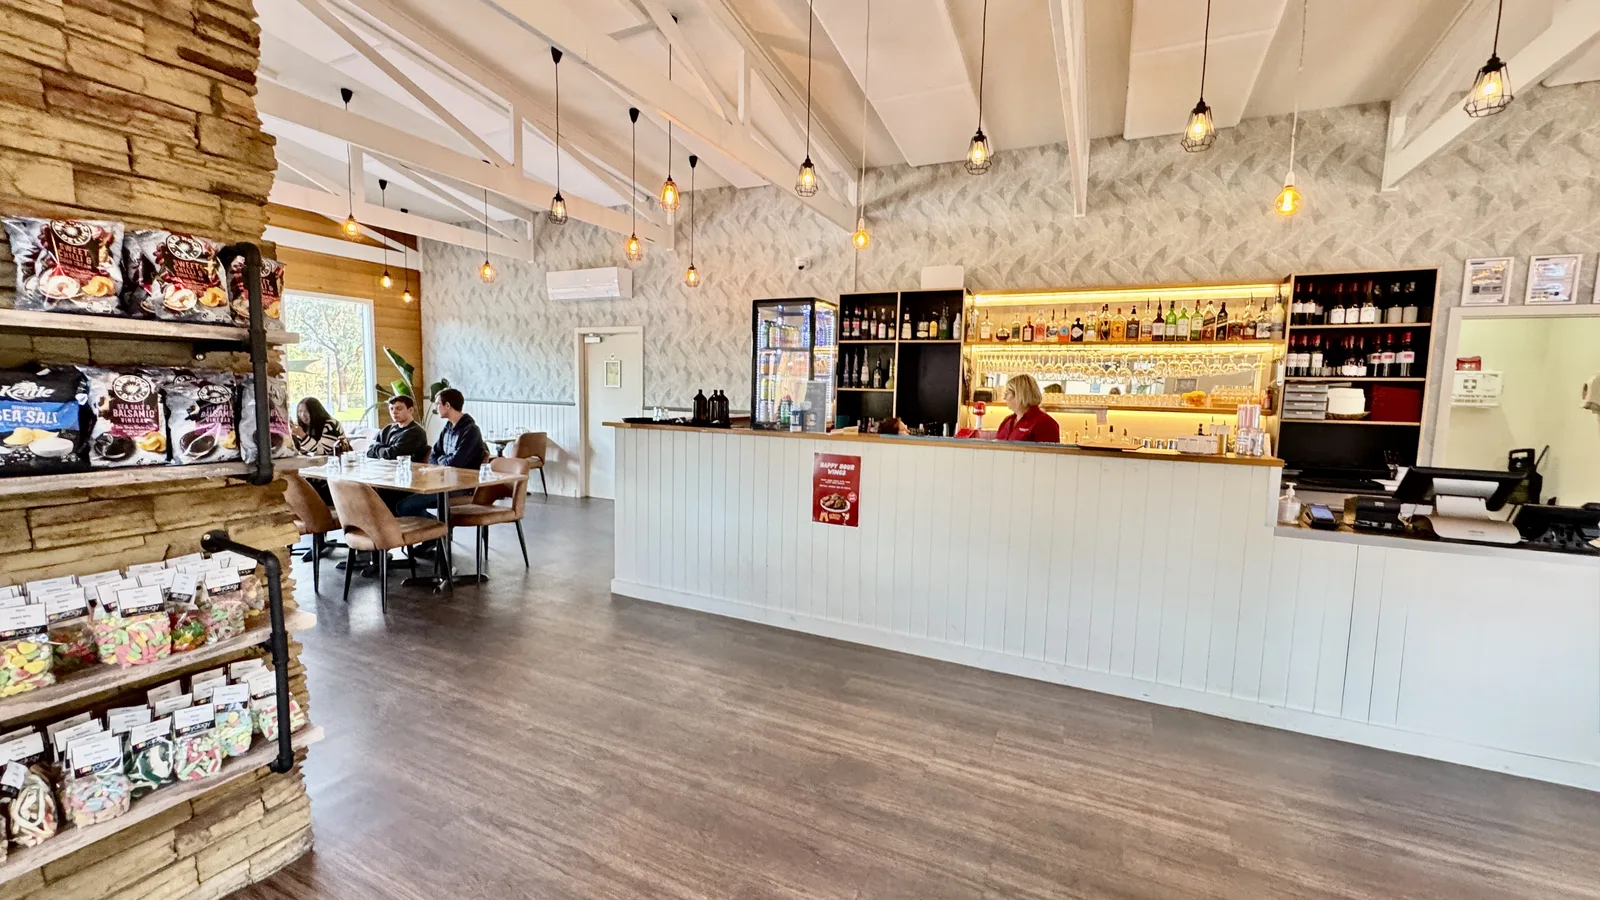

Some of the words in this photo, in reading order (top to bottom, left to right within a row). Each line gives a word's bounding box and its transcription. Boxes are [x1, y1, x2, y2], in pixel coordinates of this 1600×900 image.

[59, 243, 89, 257] SWEET
[59, 250, 84, 262] CHILLI
[172, 259, 199, 269] SWEET
[0, 384, 55, 401] Kettle
[11, 404, 42, 412] ORIGINAL
[112, 408, 155, 418] BALSAMIC
[26, 411, 58, 424] SALT
[820, 461, 838, 469] HAPPY
[839, 463, 855, 471] HOUR
[827, 468, 846, 476] WINGS
